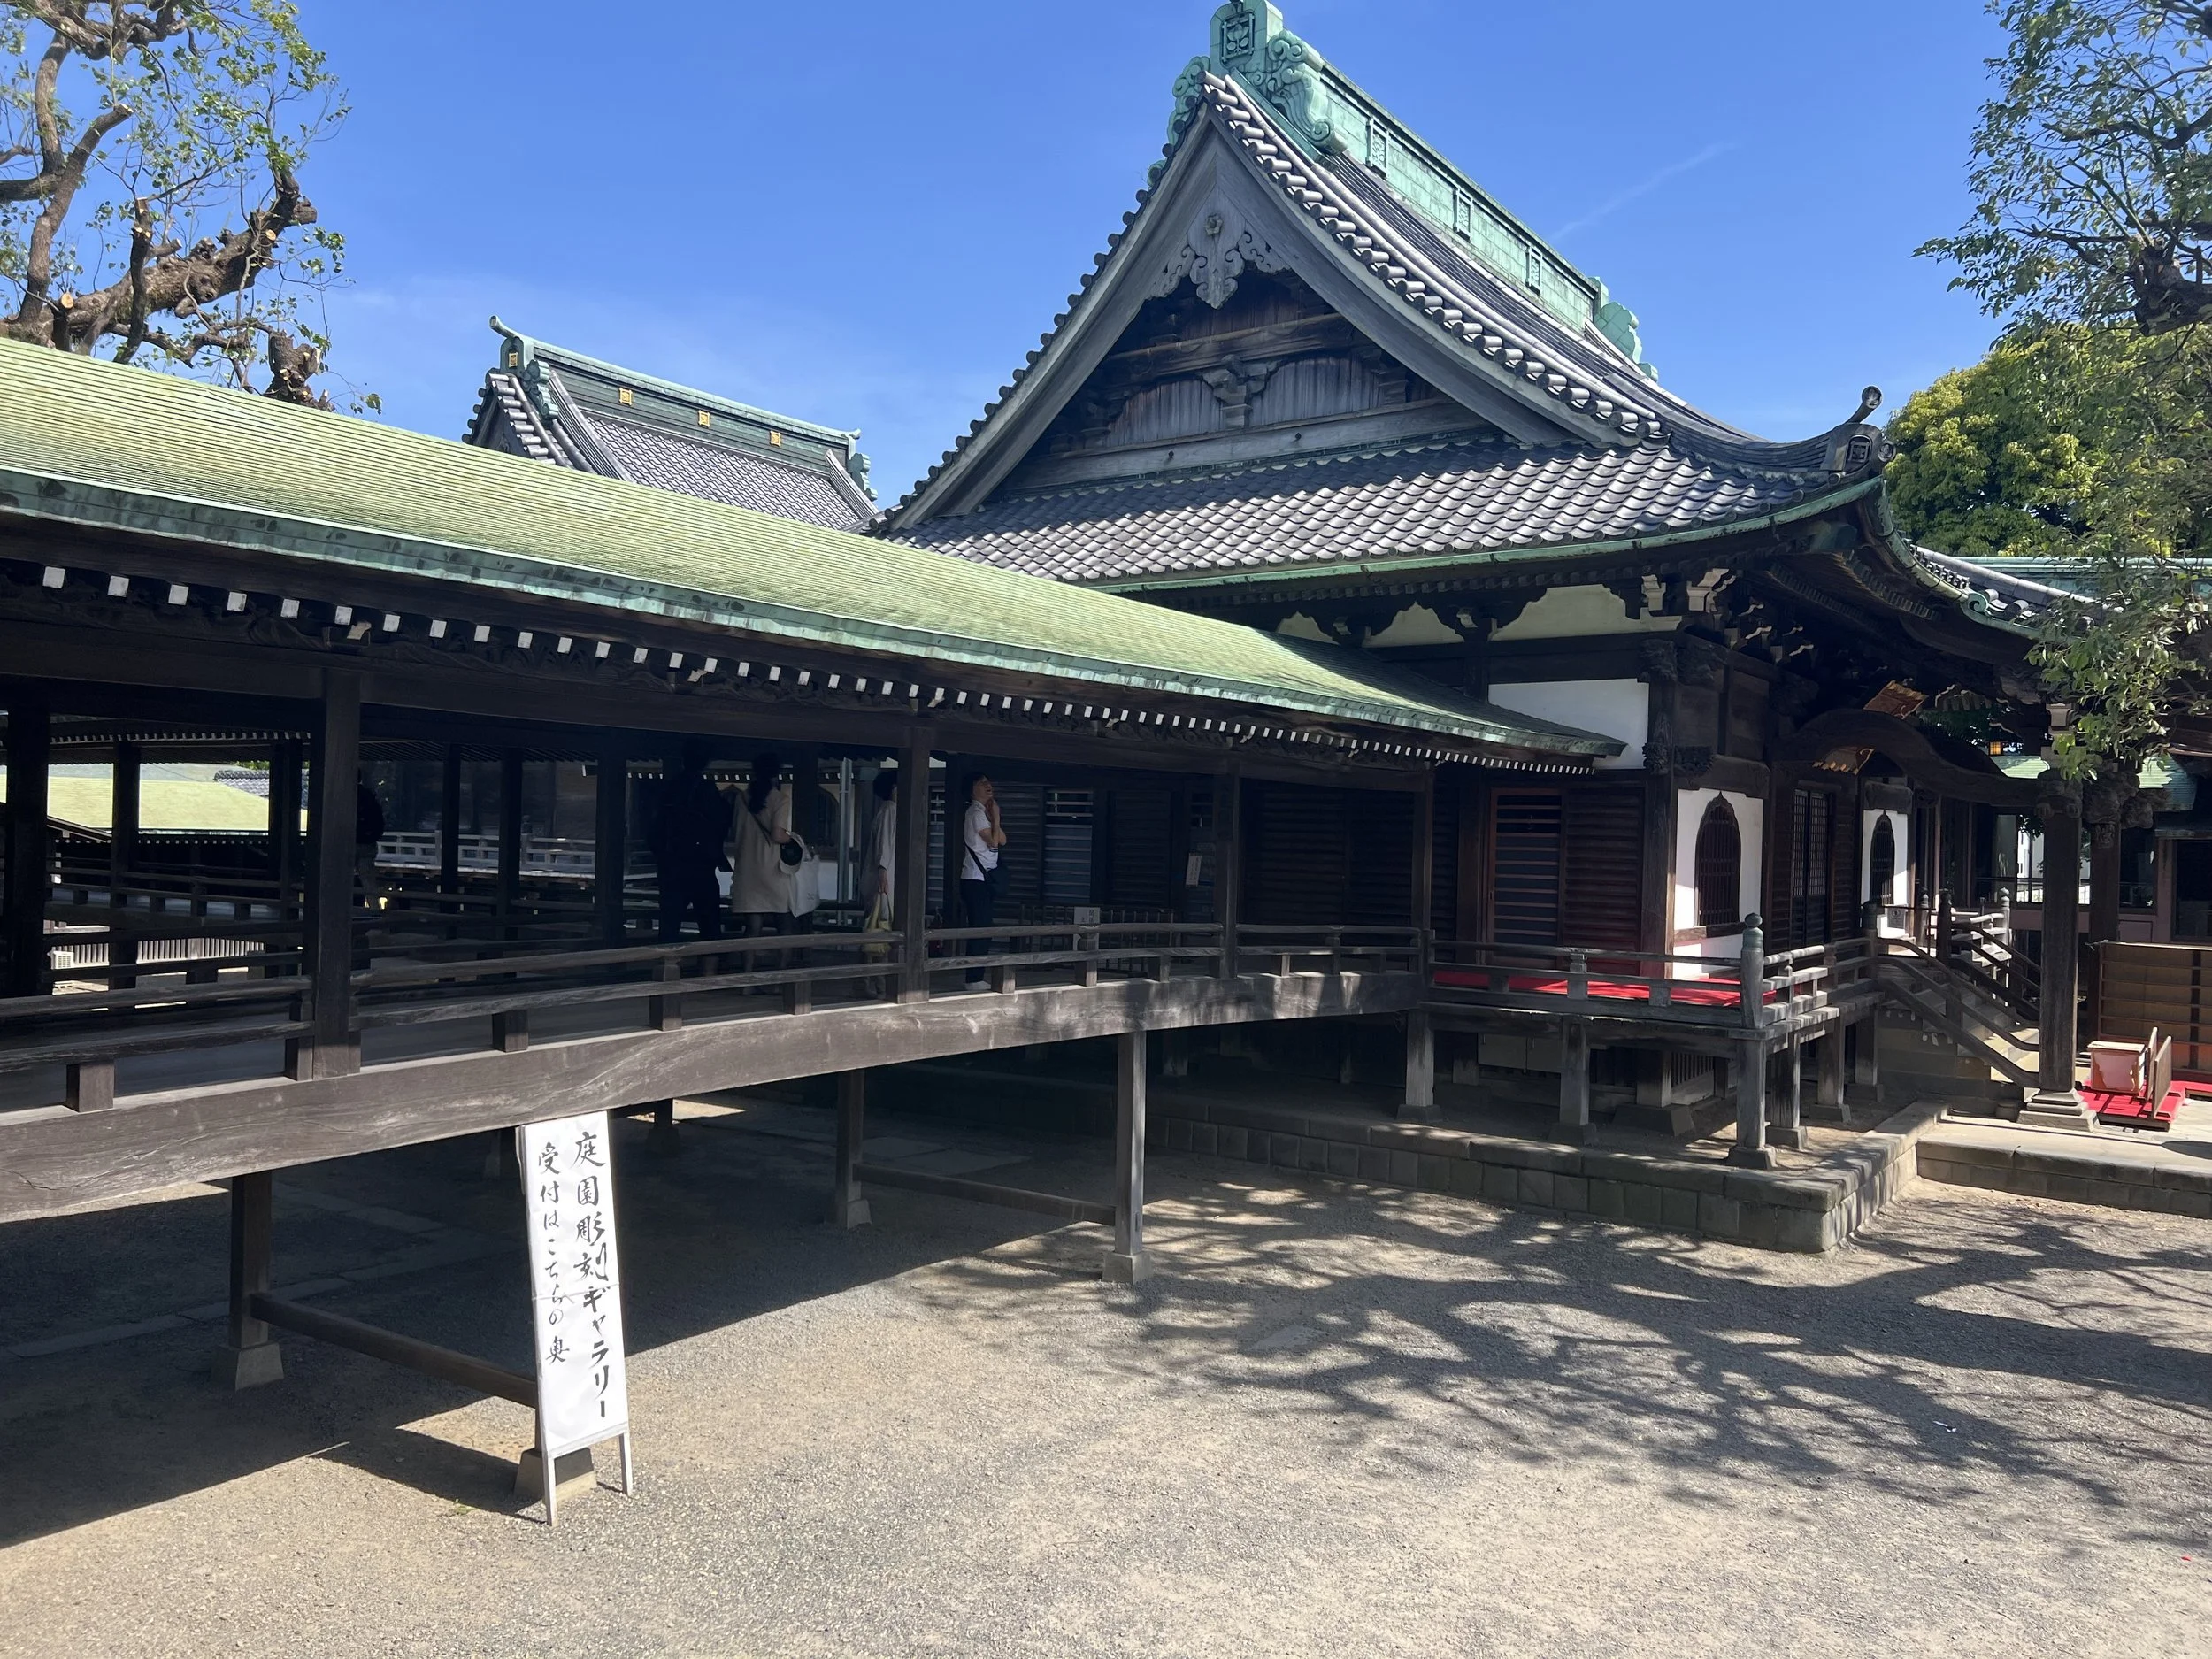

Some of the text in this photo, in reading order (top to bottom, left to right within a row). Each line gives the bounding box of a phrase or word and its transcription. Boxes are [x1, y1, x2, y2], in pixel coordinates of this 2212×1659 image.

[538, 1142, 571, 1363] 受付はこちらの奥
[572, 1132, 611, 1417] 庭園彫刻ギャラリー
